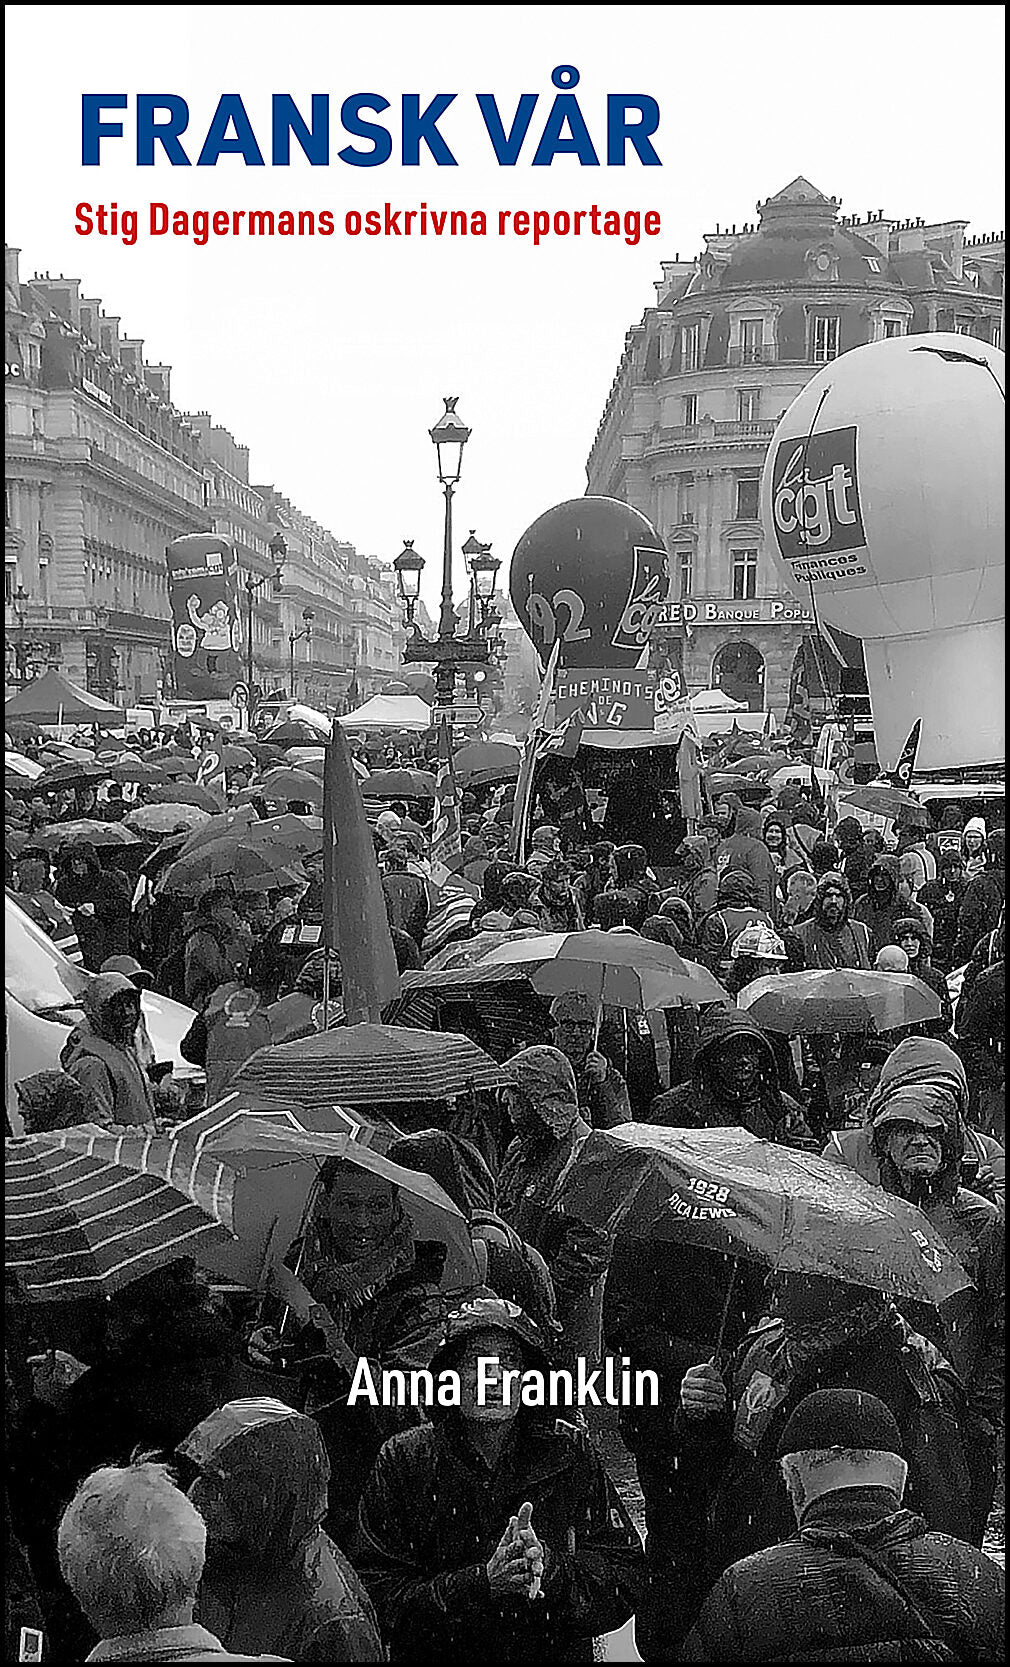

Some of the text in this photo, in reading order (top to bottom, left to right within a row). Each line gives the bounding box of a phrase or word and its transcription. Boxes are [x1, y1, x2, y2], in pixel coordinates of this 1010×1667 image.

[774, 463, 858, 546] cgt
[790, 553, 859, 571] Finances
[794, 564, 868, 584] Publiques
[525, 588, 592, 645] 92
[705, 602, 760, 620] BANQUE
[558, 677, 654, 700] CHEMINOTS
[598, 695, 612, 705] DE
[687, 1177, 731, 1203] 1928
